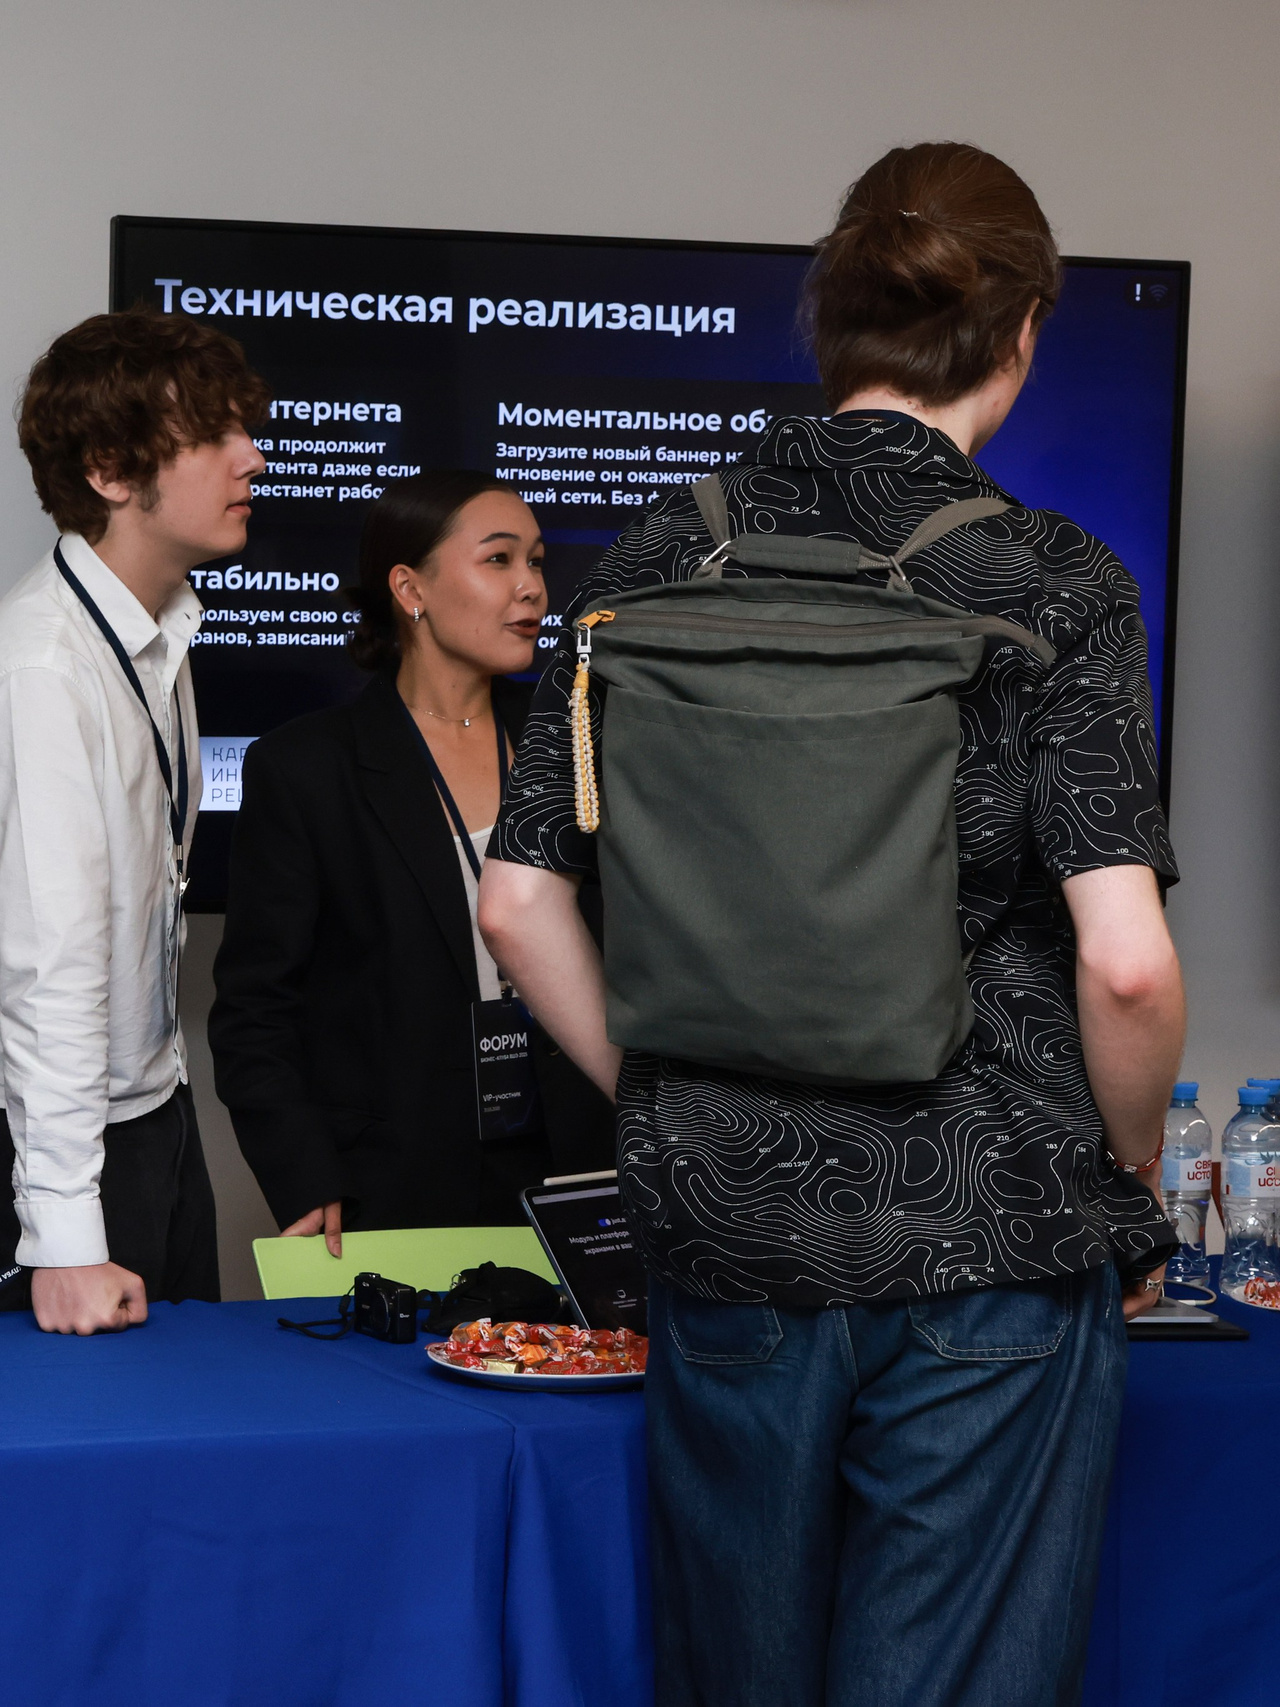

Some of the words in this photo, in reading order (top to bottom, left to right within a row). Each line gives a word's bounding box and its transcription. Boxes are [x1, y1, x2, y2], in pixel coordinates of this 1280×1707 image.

[154, 278, 453, 324] Техническая
[468, 296, 736, 337] реализация
[498, 402, 723, 432] Моментальное
[730, 408, 774, 434] об
[253, 438, 274, 451] ка
[279, 439, 387, 455] продолжит
[496, 442, 589, 462] Загрузите
[593, 446, 651, 462] новый
[655, 446, 722, 467] баннер
[885, 446, 902, 454] 1000
[265, 461, 318, 475] тента
[322, 464, 373, 477] даже
[377, 465, 421, 478] если
[496, 468, 596, 482] мгновение
[600, 470, 623, 483] он
[250, 483, 334, 500] рестанет
[339, 483, 387, 501] рабо
[519, 488, 557, 503] шей
[561, 491, 607, 505] сети.
[611, 490, 644, 506] Без
[189, 564, 340, 592] табильно
[289, 610, 338, 624] свою
[541, 614, 563, 627] их
[190, 631, 252, 647] ранов,
[480, 1032, 528, 1053] ФОРУМ
